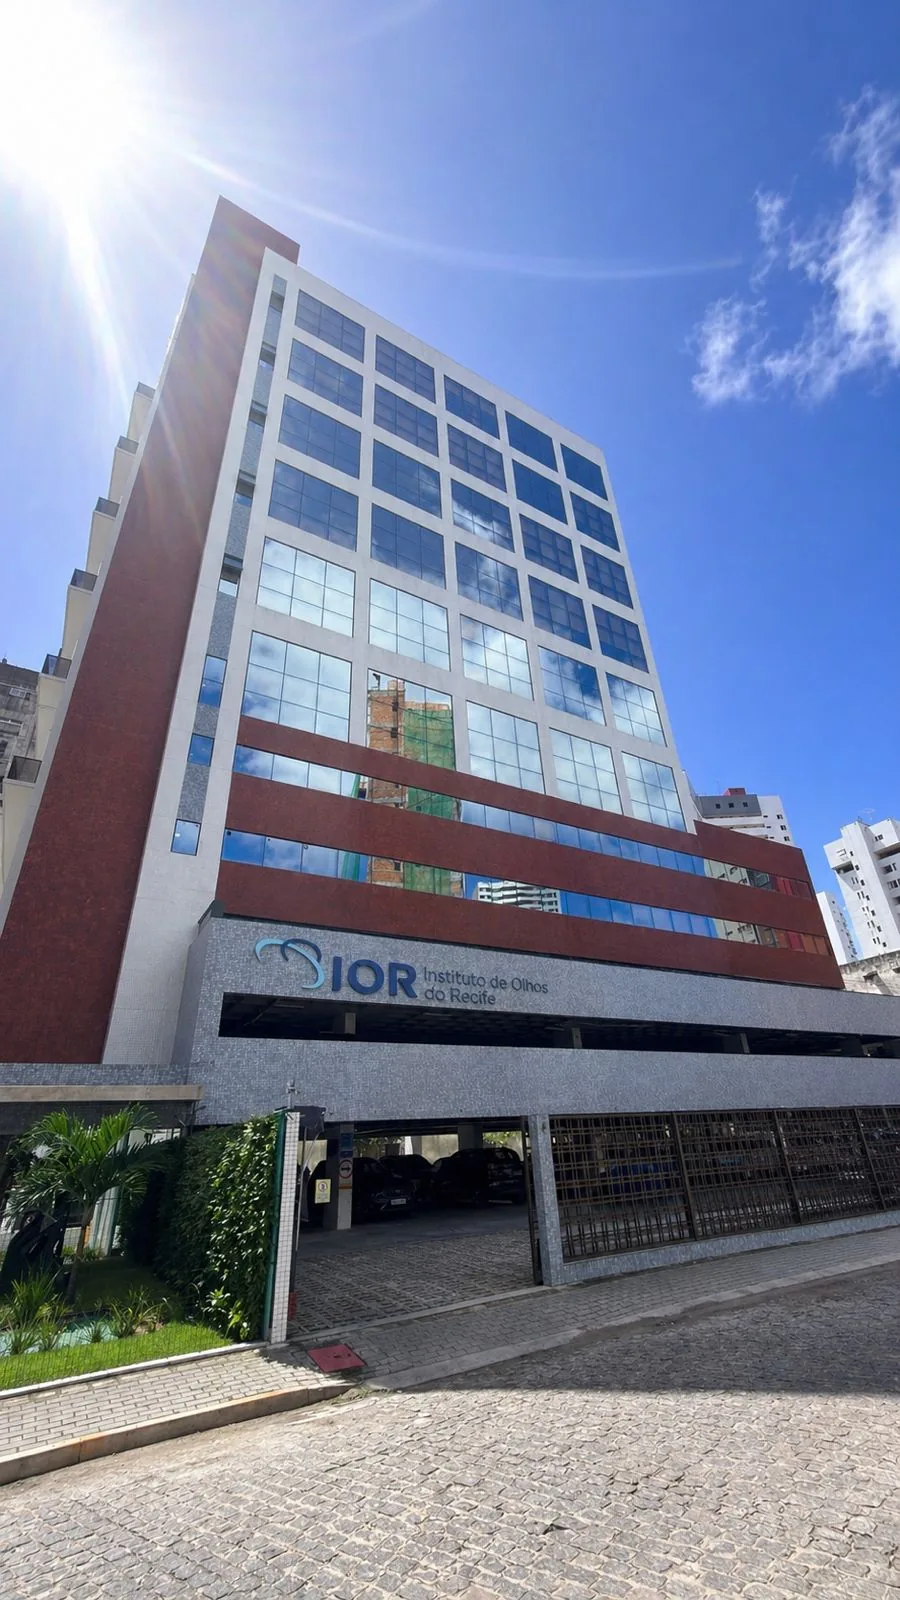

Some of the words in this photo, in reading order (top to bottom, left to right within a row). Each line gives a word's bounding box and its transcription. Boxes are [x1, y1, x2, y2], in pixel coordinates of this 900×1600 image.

[331, 956, 418, 998] IOR
[423, 966, 486, 988] Instituto
[489, 975, 507, 990] de
[511, 977, 549, 994] Olhos
[424, 985, 445, 1001] do
[450, 987, 496, 1005] Recife
